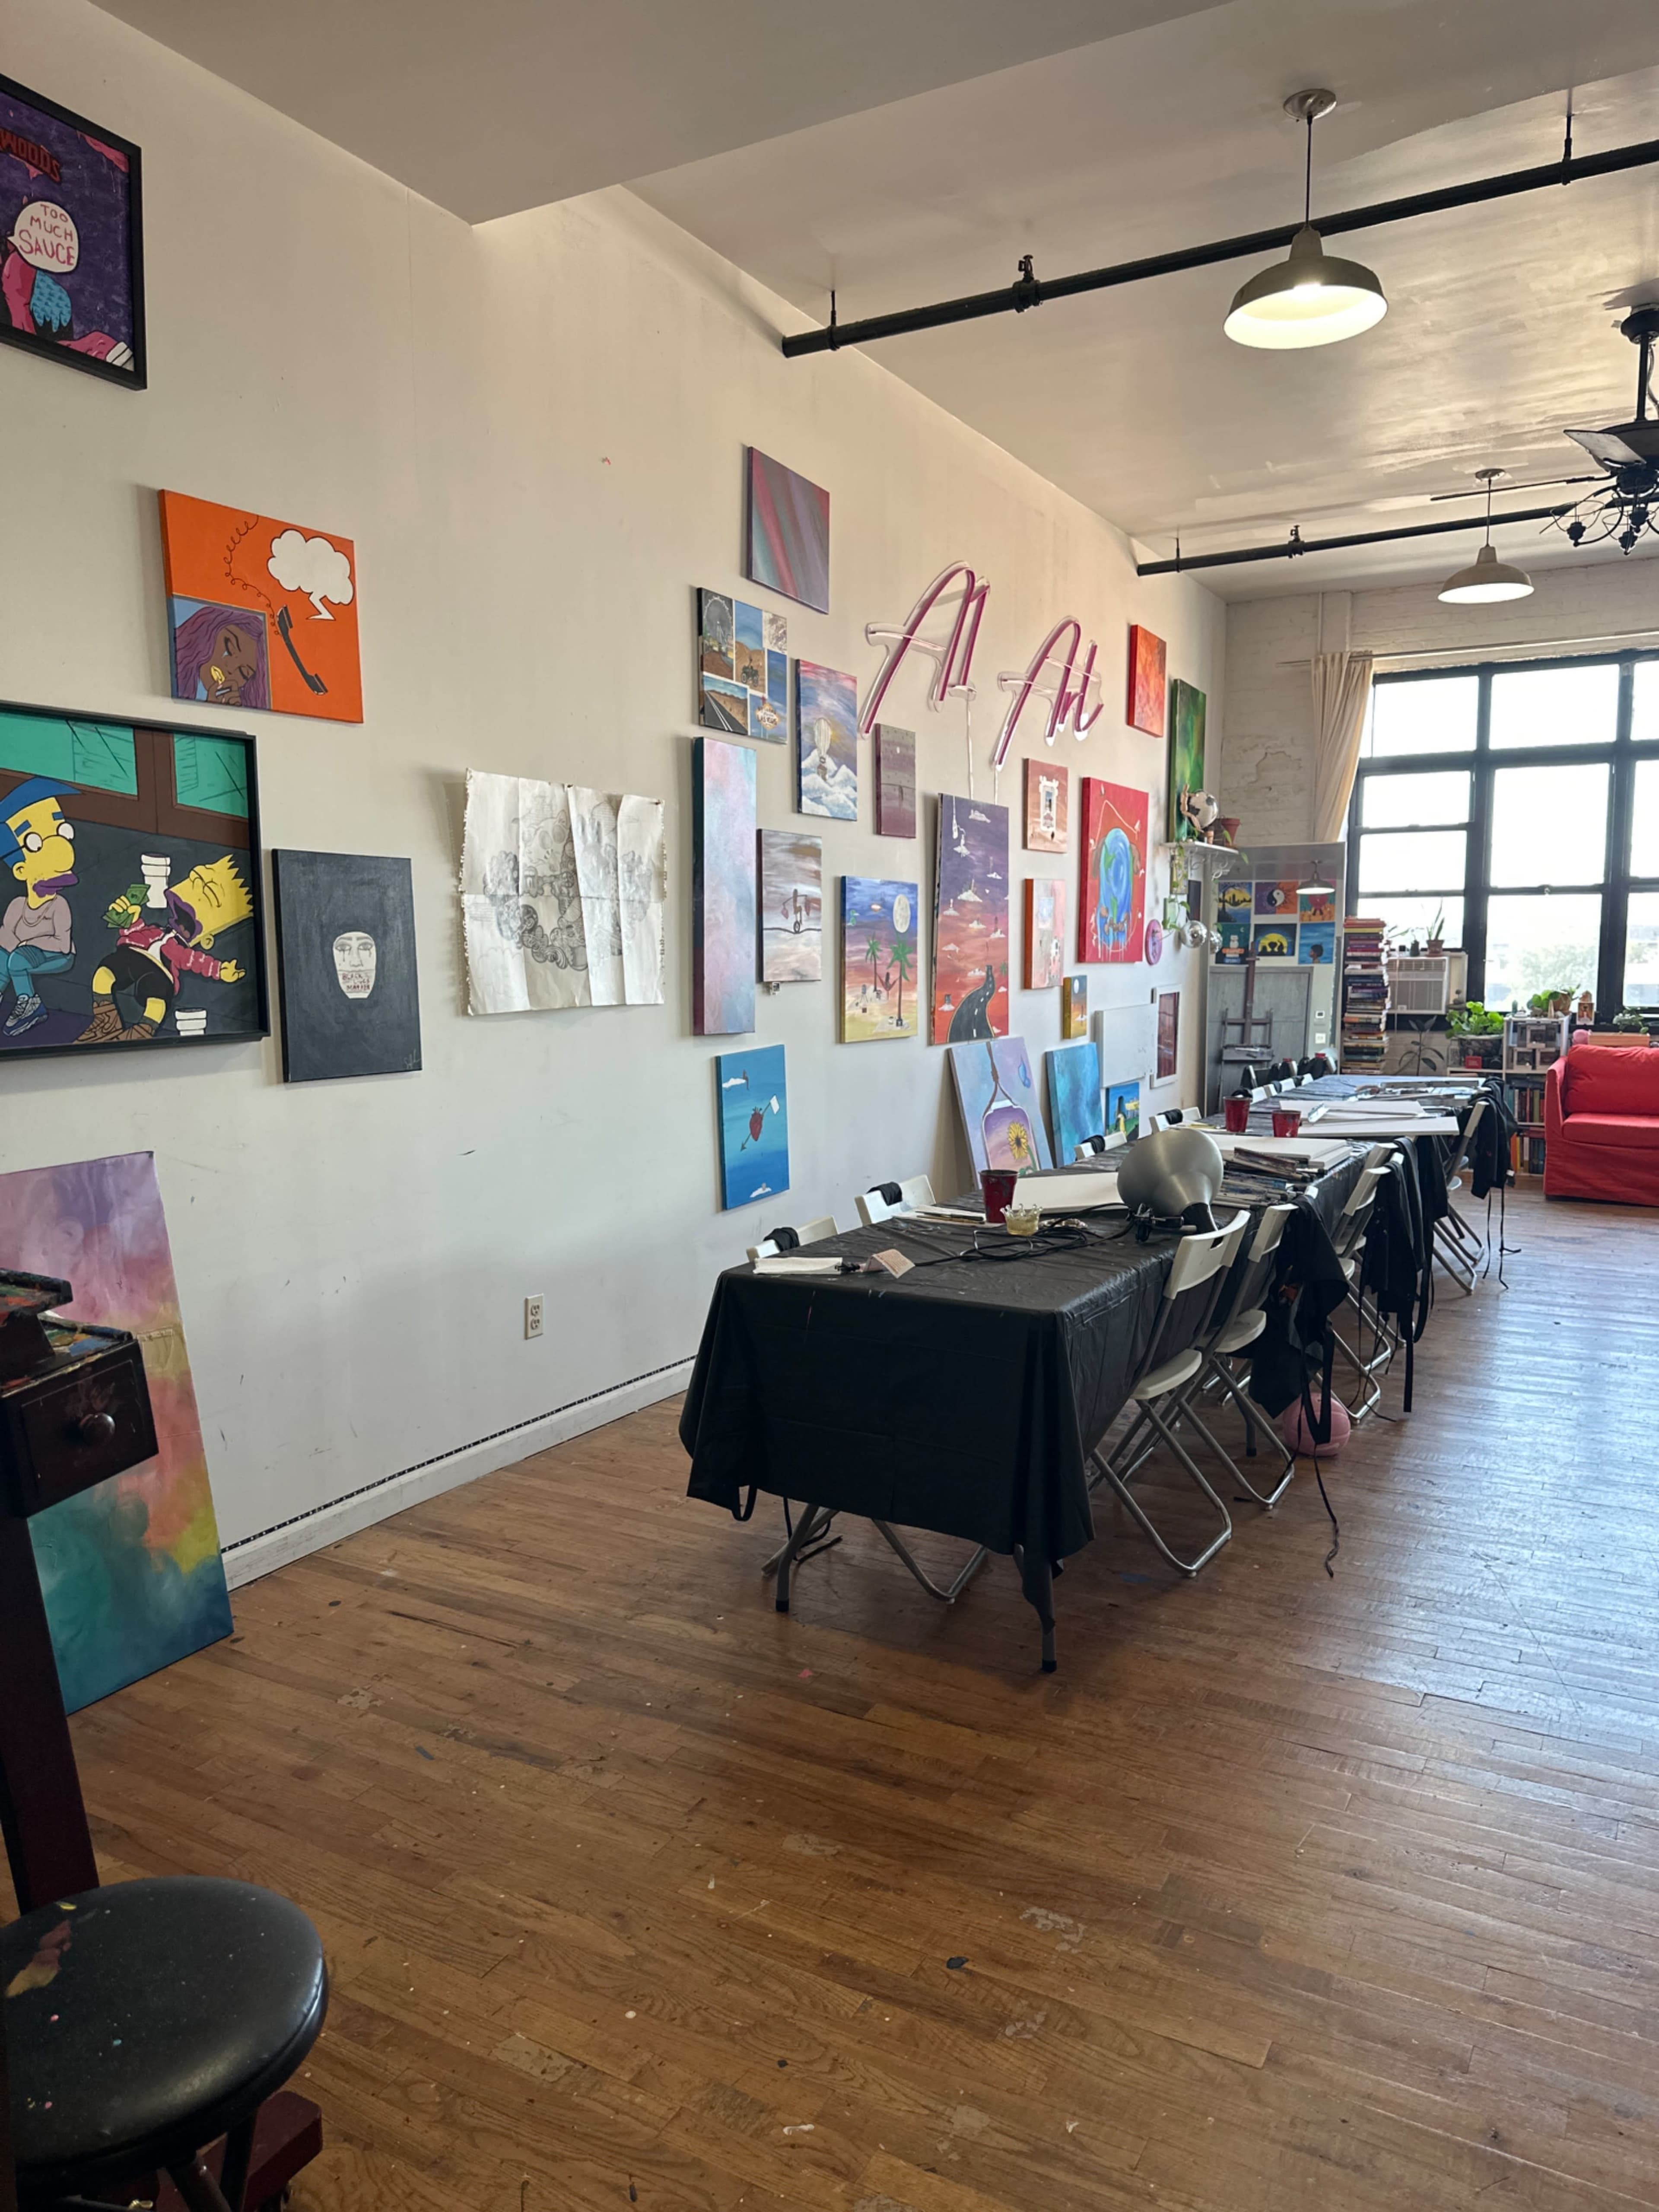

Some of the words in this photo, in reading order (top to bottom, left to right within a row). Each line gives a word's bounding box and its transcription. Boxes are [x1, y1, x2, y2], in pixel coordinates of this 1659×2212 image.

[0, 127, 60, 182] WOODS
[30, 215, 73, 242] MUCH
[40, 204, 68, 222] TOO
[19, 229, 75, 266] SAUCE
[995, 618, 1104, 767] Art
